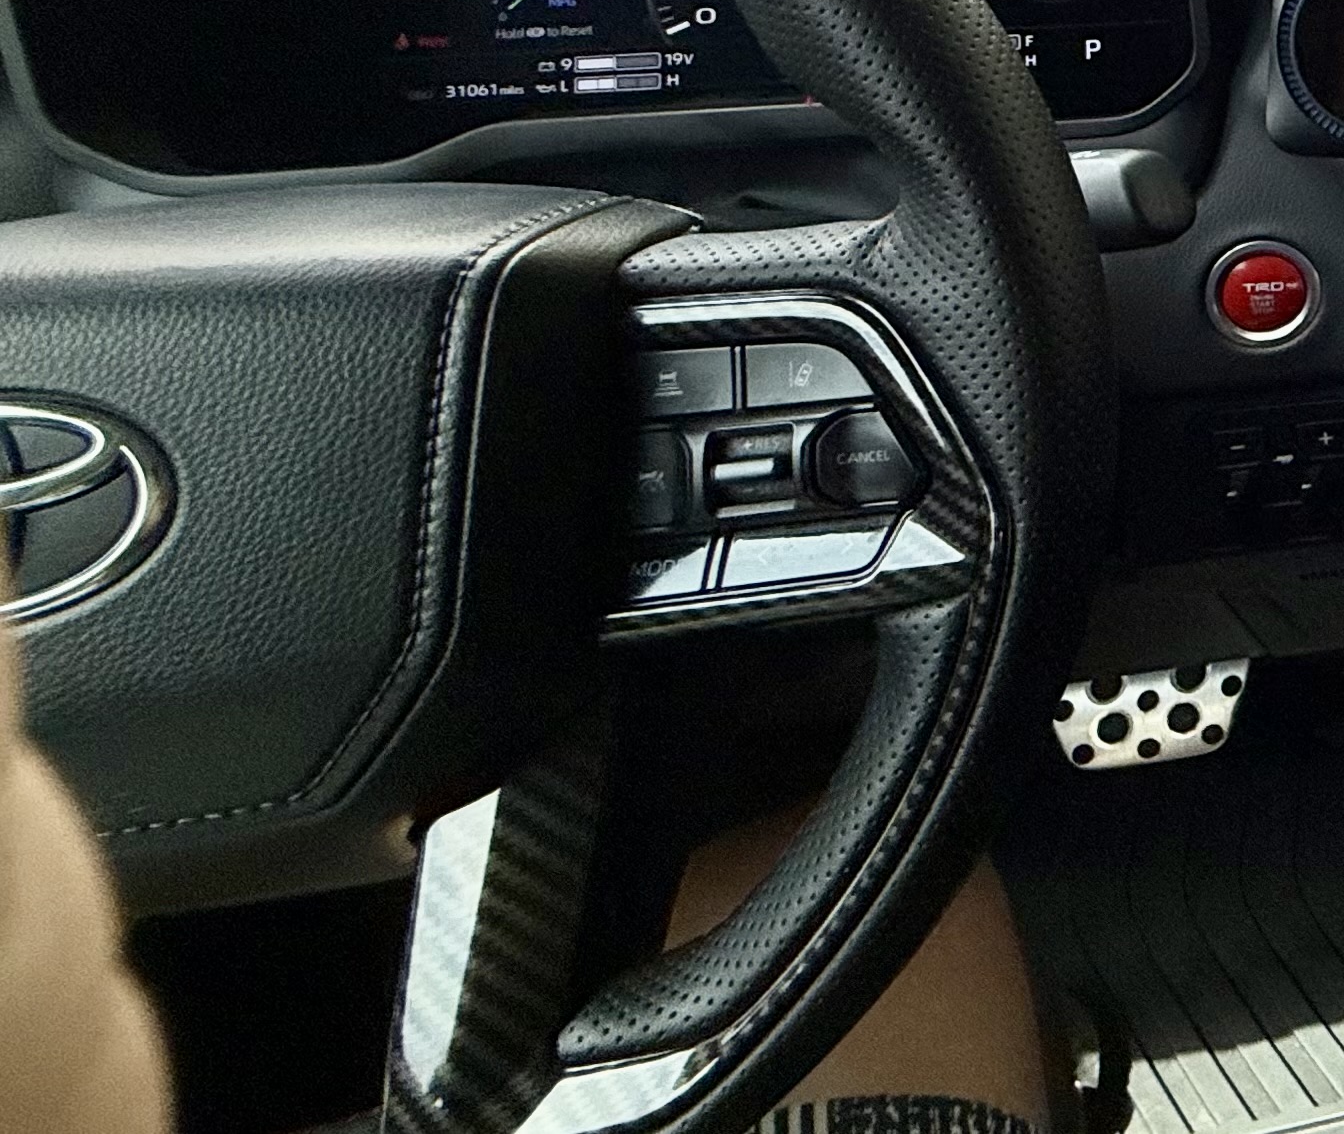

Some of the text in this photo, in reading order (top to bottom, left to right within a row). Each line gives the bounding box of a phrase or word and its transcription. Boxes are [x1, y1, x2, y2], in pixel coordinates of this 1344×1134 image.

[695, 7, 718, 25] 0
[495, 28, 525, 39] Hold
[547, 28, 559, 37] to
[561, 26, 593, 36] Reset
[1025, 35, 1034, 47] F
[1085, 39, 1102, 60] P
[560, 59, 573, 71] 9
[664, 53, 695, 66] 19V
[1025, 54, 1037, 67] H
[666, 74, 680, 86] H
[445, 83, 497, 99] 31061
[1242, 281, 1285, 293] TRD
[836, 450, 892, 466] CANCEL
